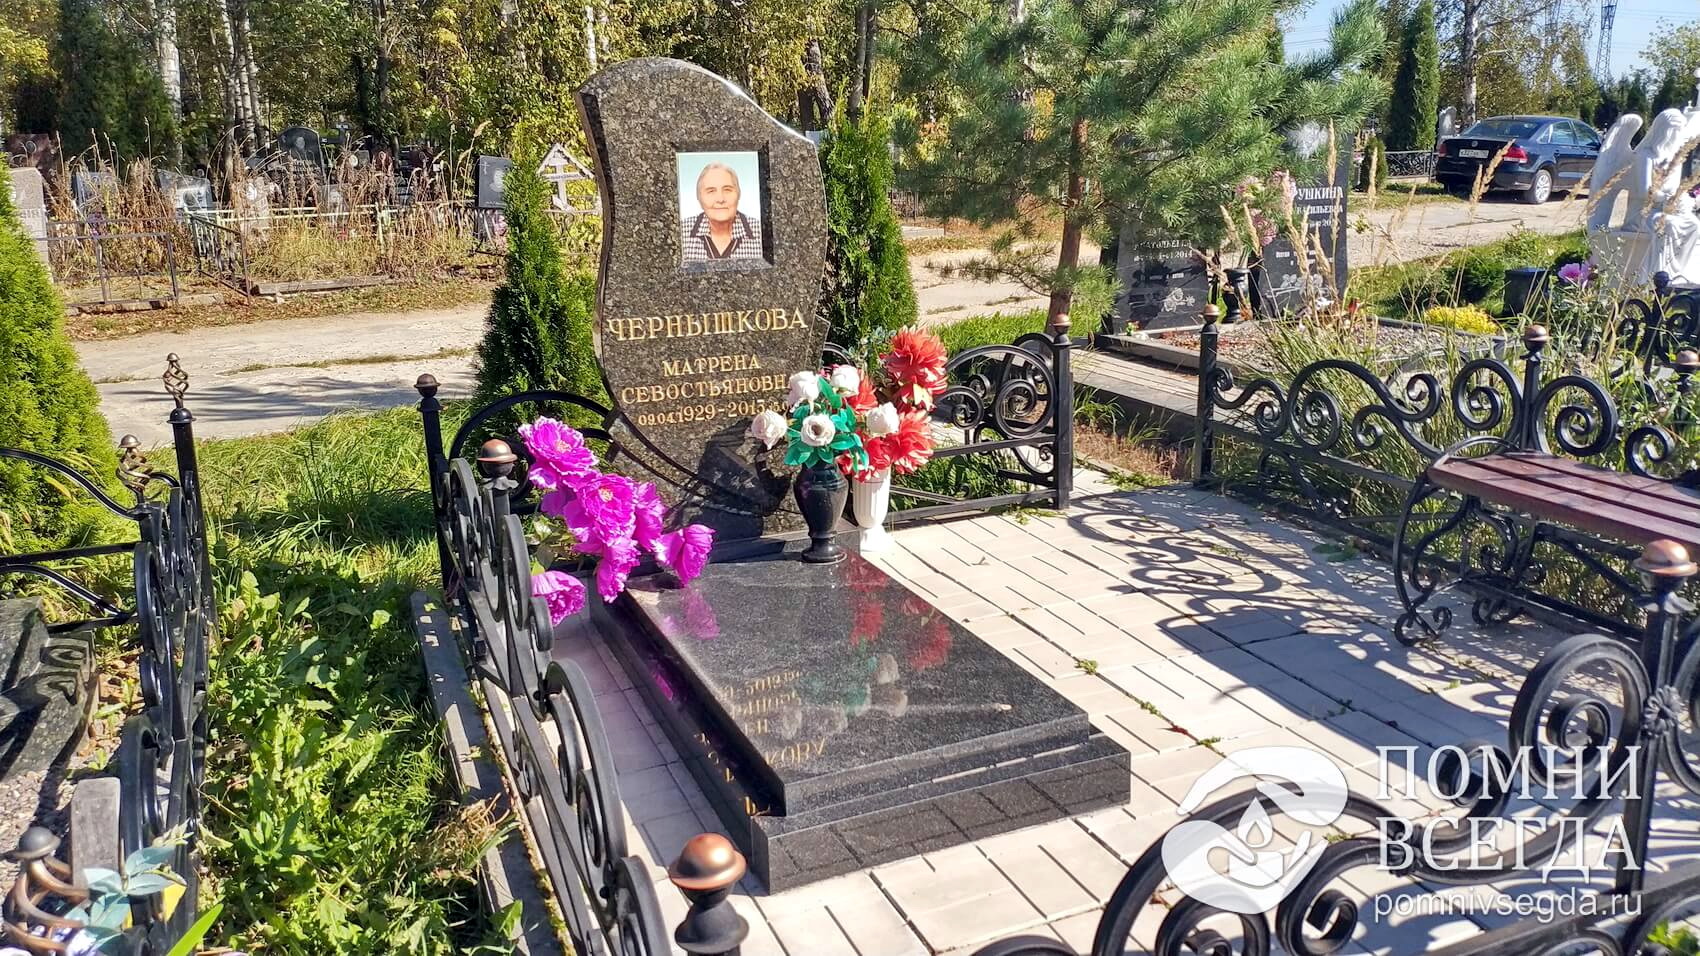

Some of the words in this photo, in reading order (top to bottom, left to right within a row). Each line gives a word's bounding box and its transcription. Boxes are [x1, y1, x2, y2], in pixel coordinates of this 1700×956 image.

[606, 308, 808, 341] ЧЕРНЫШКОВА
[662, 354, 761, 377] МАТРЕНА
[621, 374, 789, 404] СЕВОСТЬЯНОВН
